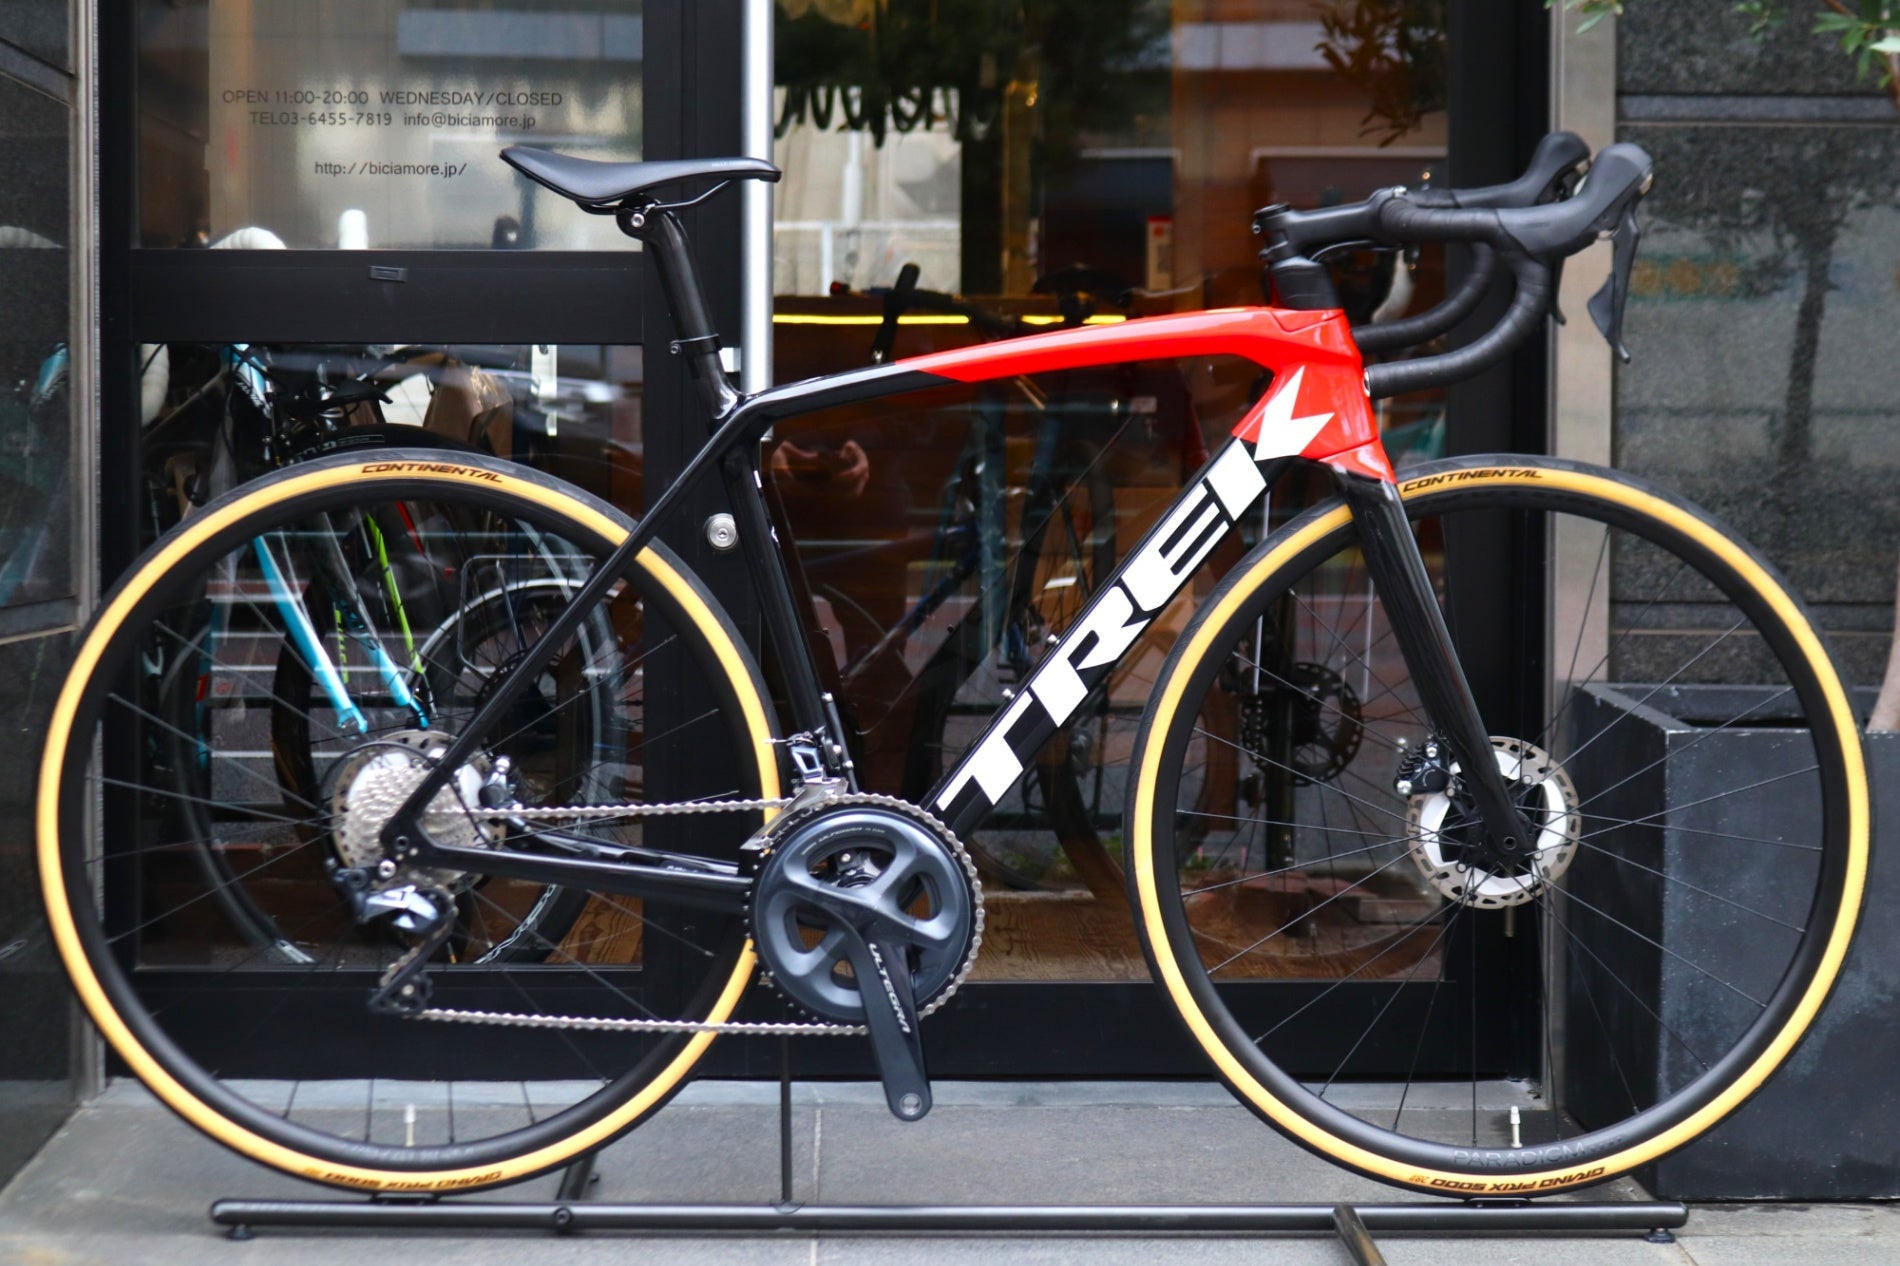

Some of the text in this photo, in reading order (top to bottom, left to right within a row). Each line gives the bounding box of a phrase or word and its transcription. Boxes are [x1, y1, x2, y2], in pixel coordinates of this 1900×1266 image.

[222, 90, 563, 106] OPEN 11:00-20:00 WEDNESDAY/CLOSED
[250, 112, 536, 129] TEL03-6455-7819 info@biciamore.jp
[314, 161, 468, 178] http://biciamore.jp/
[361, 462, 503, 483] CONTINENTAL
[1402, 469, 1543, 493] CONTINENTAL
[936, 366, 1334, 811] TREK
[868, 942, 911, 1033] ULTEGRA
[1430, 1178, 1485, 1191] 5000
[1489, 1180, 1537, 1192] PRIX
[1538, 1166, 1606, 1188] GRAND
